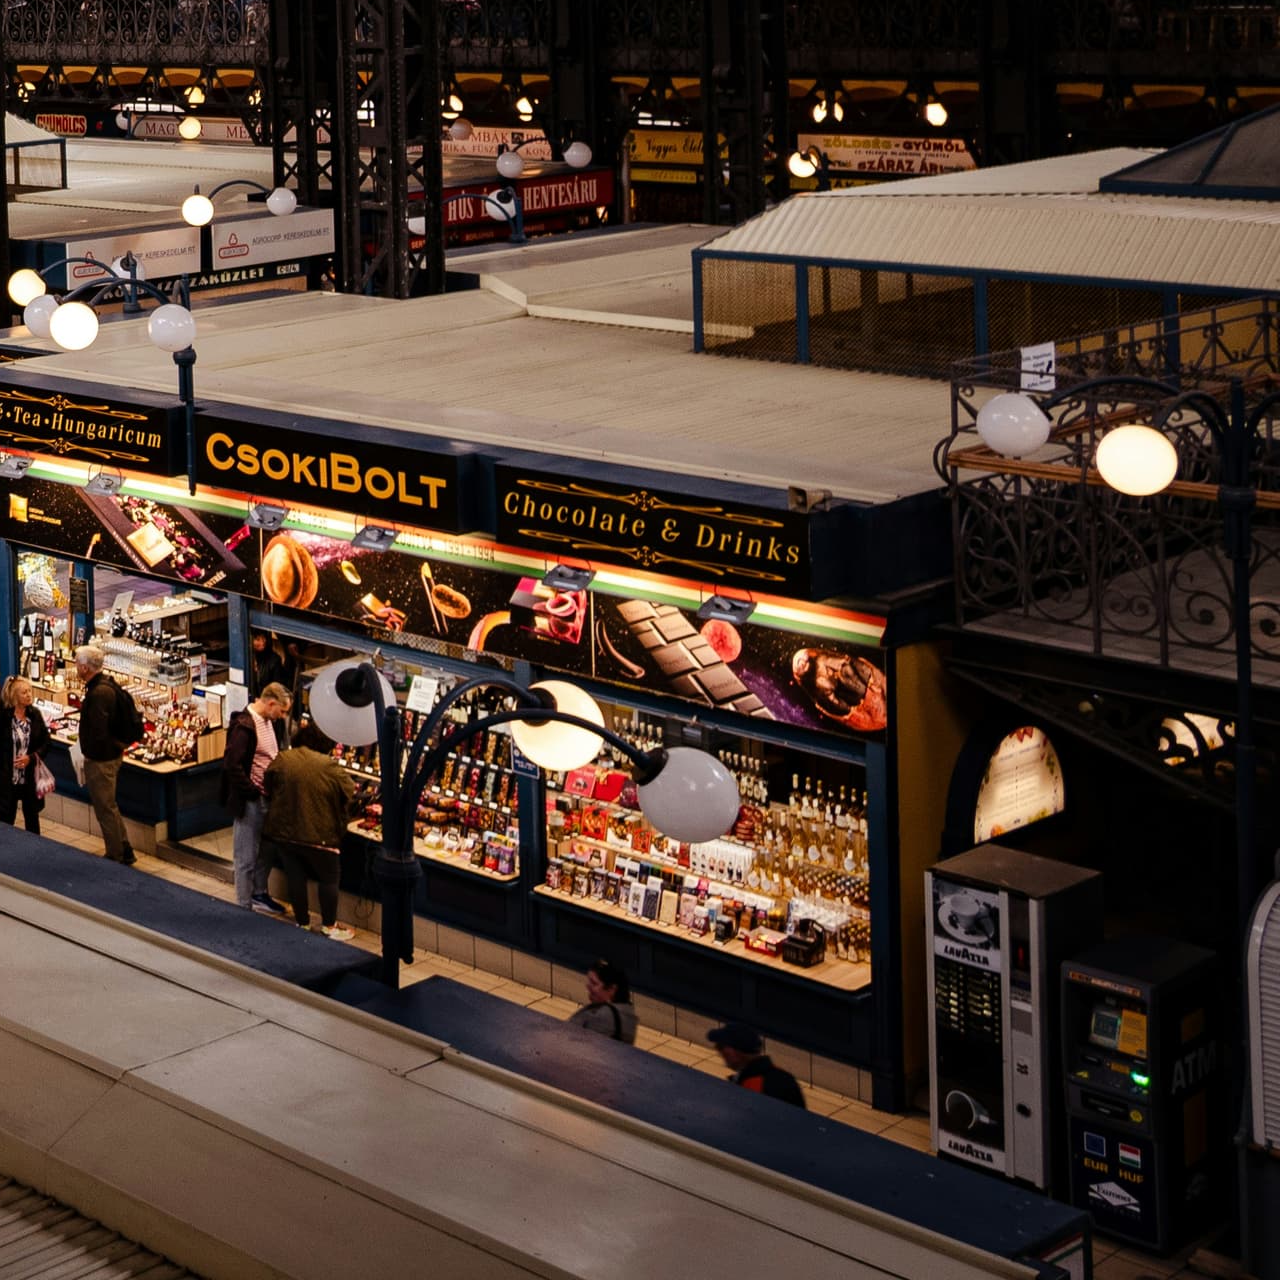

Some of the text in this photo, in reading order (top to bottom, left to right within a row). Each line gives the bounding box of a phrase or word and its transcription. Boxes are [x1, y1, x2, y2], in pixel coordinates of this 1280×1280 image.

[902, 138, 968, 153] GYÜMÖL
[522, 175, 598, 210] HENTESÁRU
[504, 491, 800, 565] Chocolate & Drinks
[944, 945, 989, 965] LAVAZZA
[948, 1140, 993, 1162] LAVAZZA
[1083, 1157, 1144, 1184] EUR HUF
